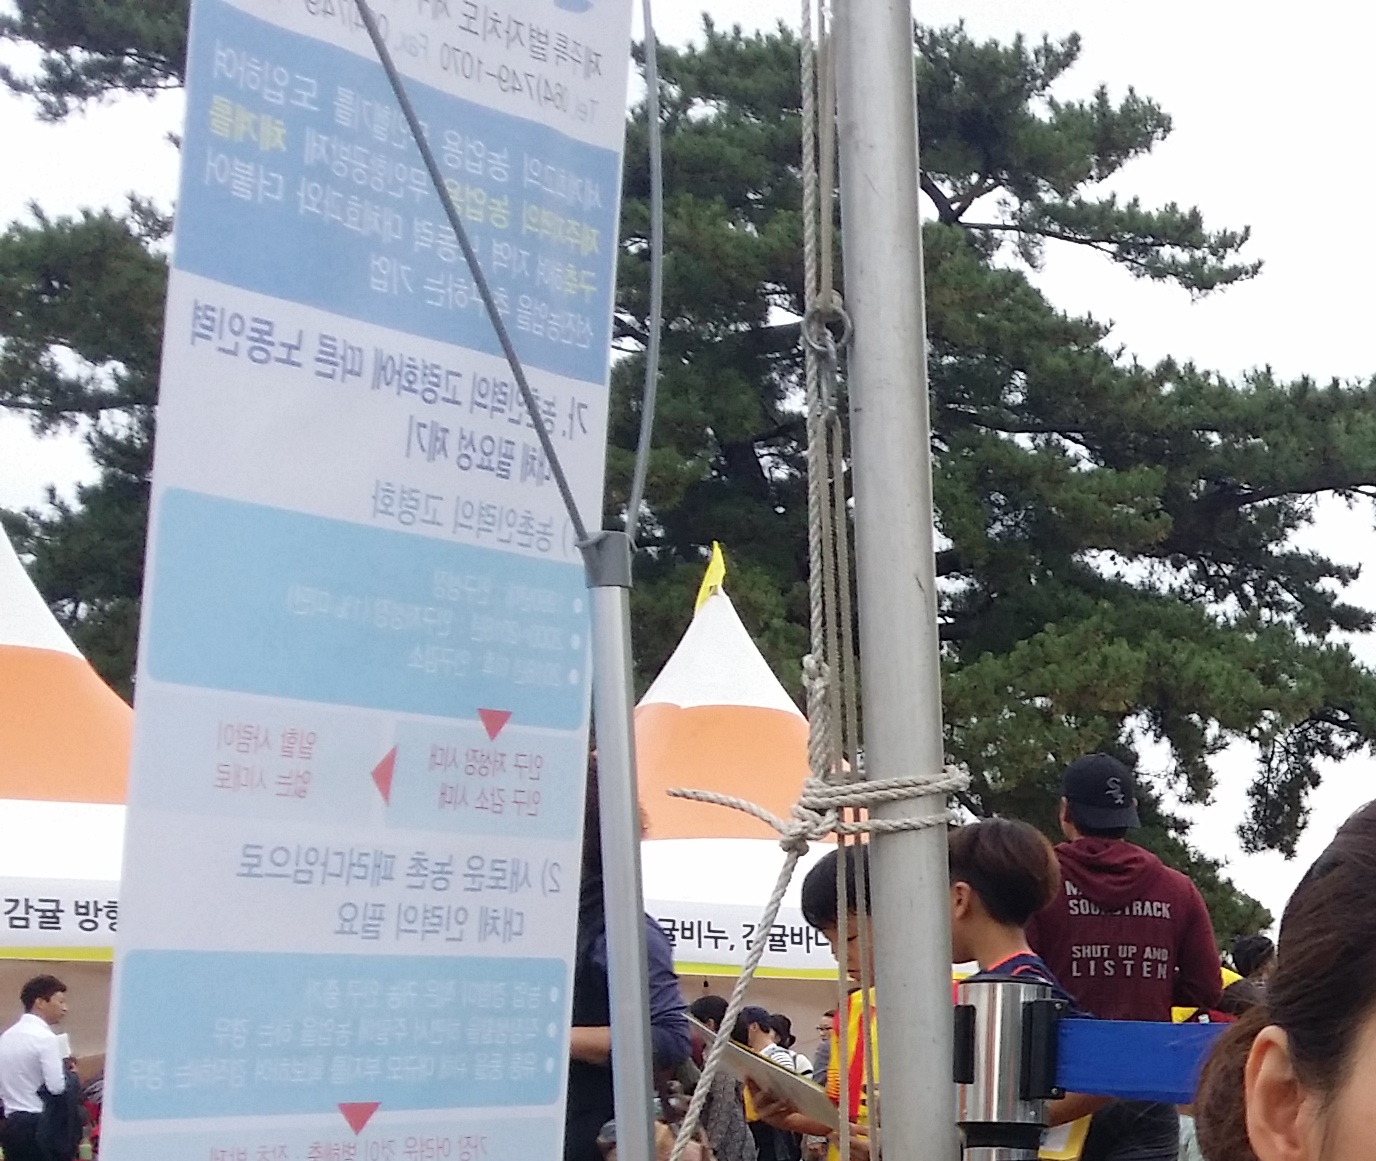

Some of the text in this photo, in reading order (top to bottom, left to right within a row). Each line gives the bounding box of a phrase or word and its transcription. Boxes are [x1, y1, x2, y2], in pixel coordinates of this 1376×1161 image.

[4, 897, 65, 931] 감귤
[1072, 945, 1168, 961] SHUT UP AND
[1072, 961, 1168, 979] LISTEN
